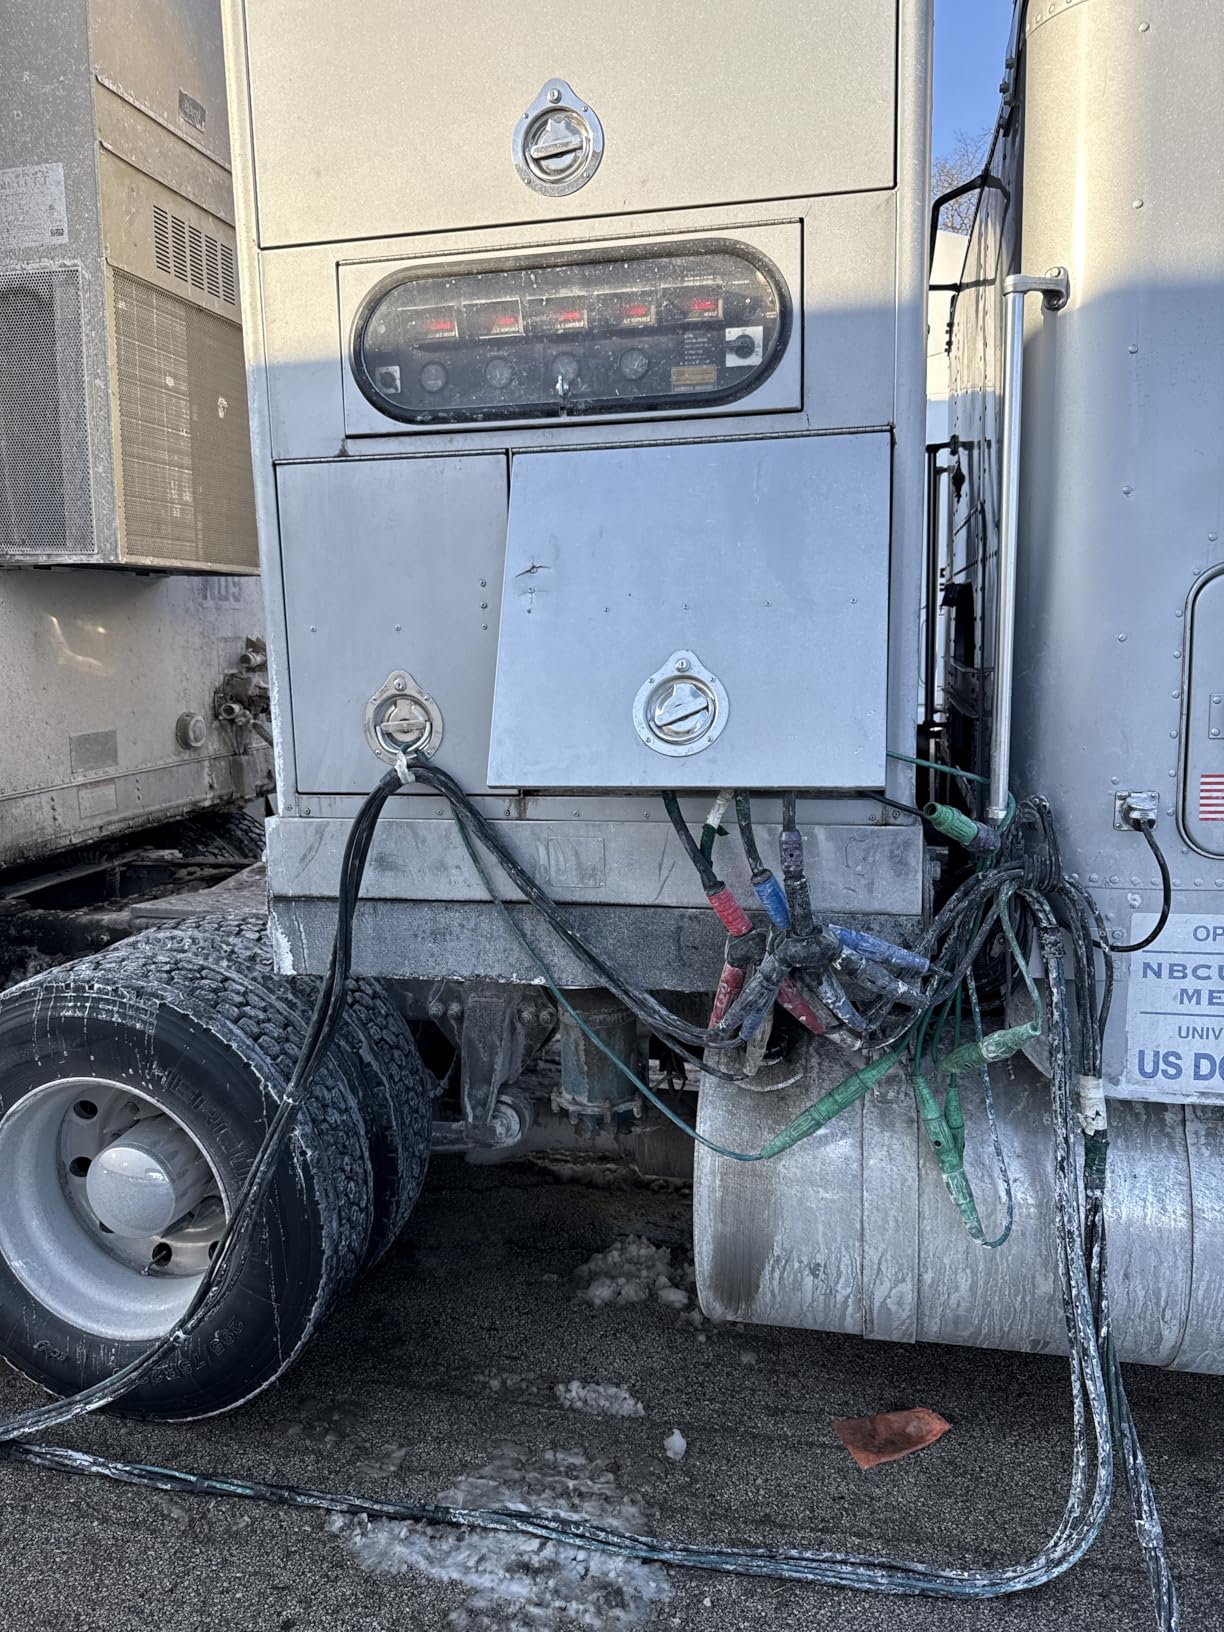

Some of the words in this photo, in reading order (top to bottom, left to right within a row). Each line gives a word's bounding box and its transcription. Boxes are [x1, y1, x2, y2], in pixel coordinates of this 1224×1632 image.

[1193, 925, 1224, 942] OP
[1179, 988, 1224, 1006] ME
[1178, 1026, 1224, 1040] UNIV
[1138, 1050, 1183, 1080] US
[1193, 1052, 1224, 1081] D
